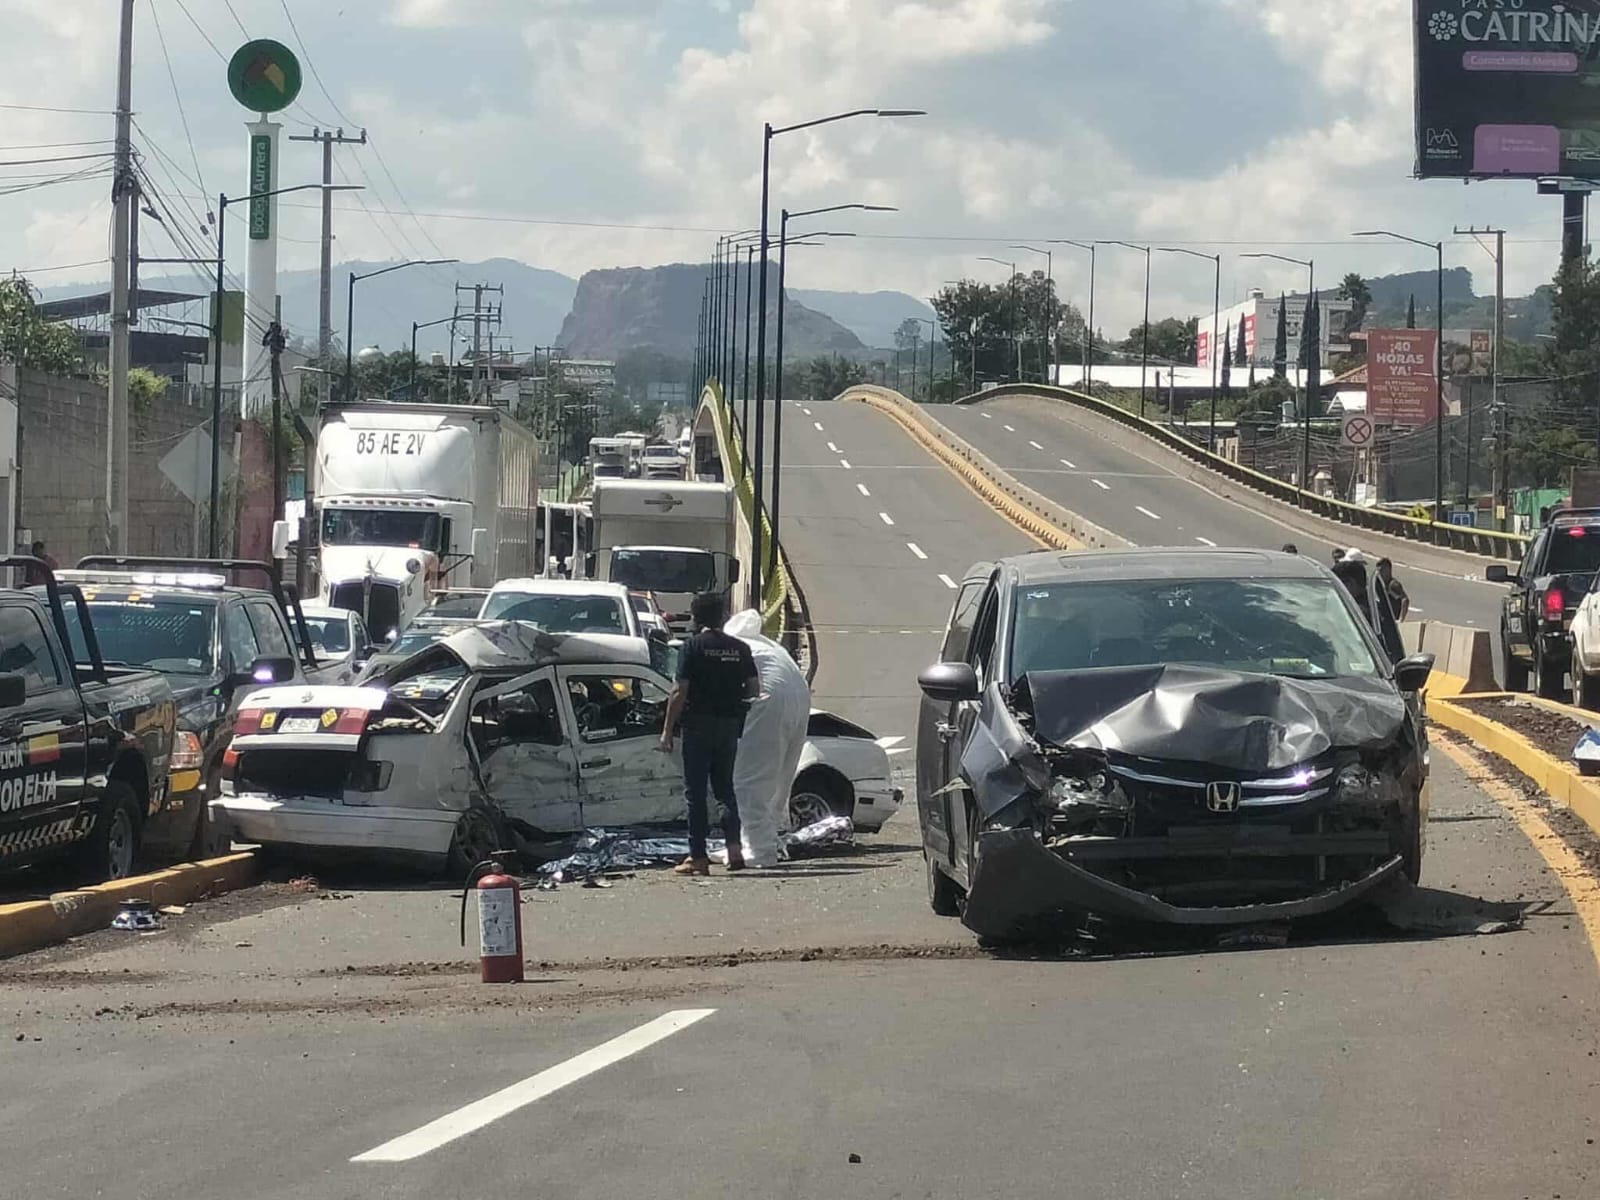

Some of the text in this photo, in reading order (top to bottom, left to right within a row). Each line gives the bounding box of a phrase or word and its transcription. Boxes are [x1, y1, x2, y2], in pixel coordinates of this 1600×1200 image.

[251, 142, 267, 234] Bodeg Aurrera
[1472, 340, 1488, 351] PT
[1376, 352, 1425, 364] HORAS
[1389, 365, 1411, 377] YA!
[357, 432, 426, 456] 85 AE 2V
[0, 742, 24, 770] LICÍA
[0, 770, 57, 812] ORELIA
